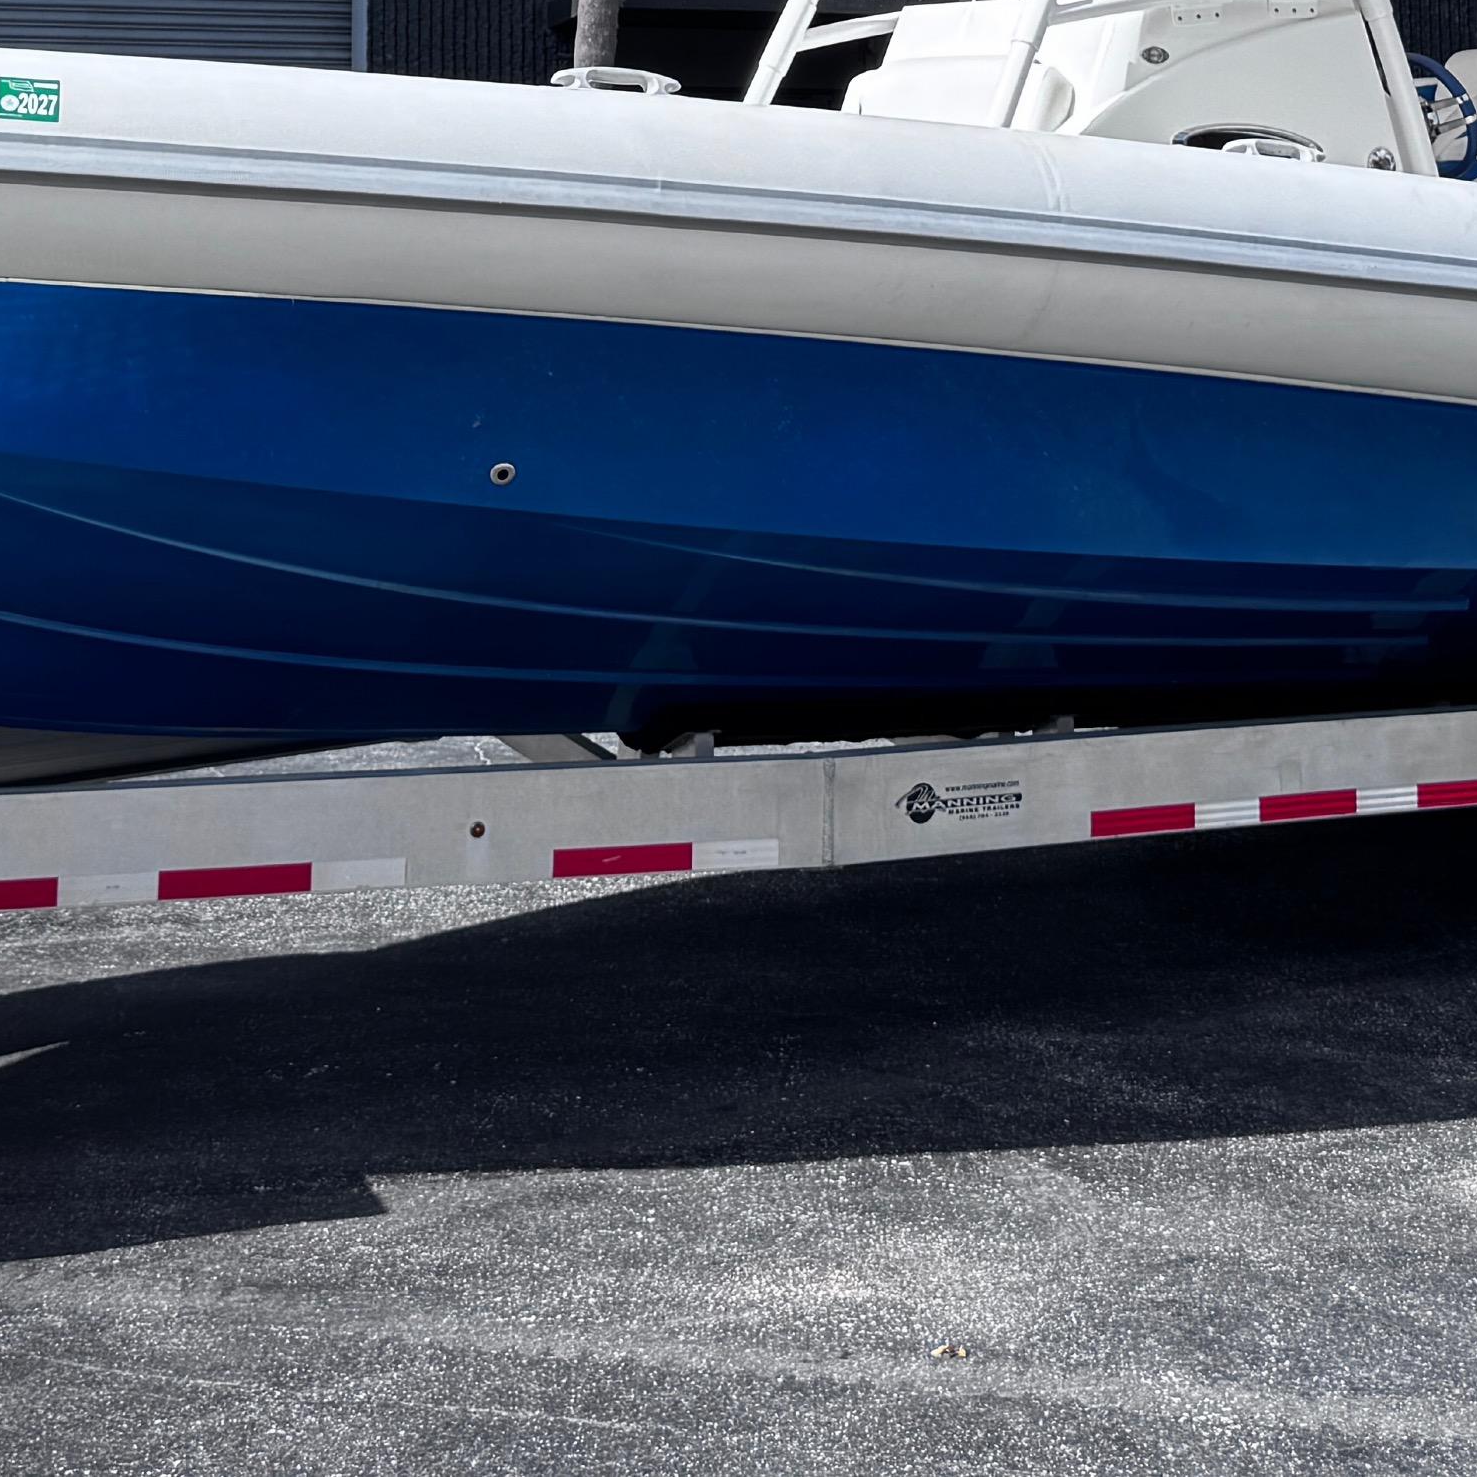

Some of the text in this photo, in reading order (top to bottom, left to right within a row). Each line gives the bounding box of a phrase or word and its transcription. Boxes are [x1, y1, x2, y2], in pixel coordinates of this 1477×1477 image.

[17, 92, 58, 116] 2027
[911, 793, 1017, 813] MANNING
[947, 803, 1020, 815] MARINE TRAILERS
